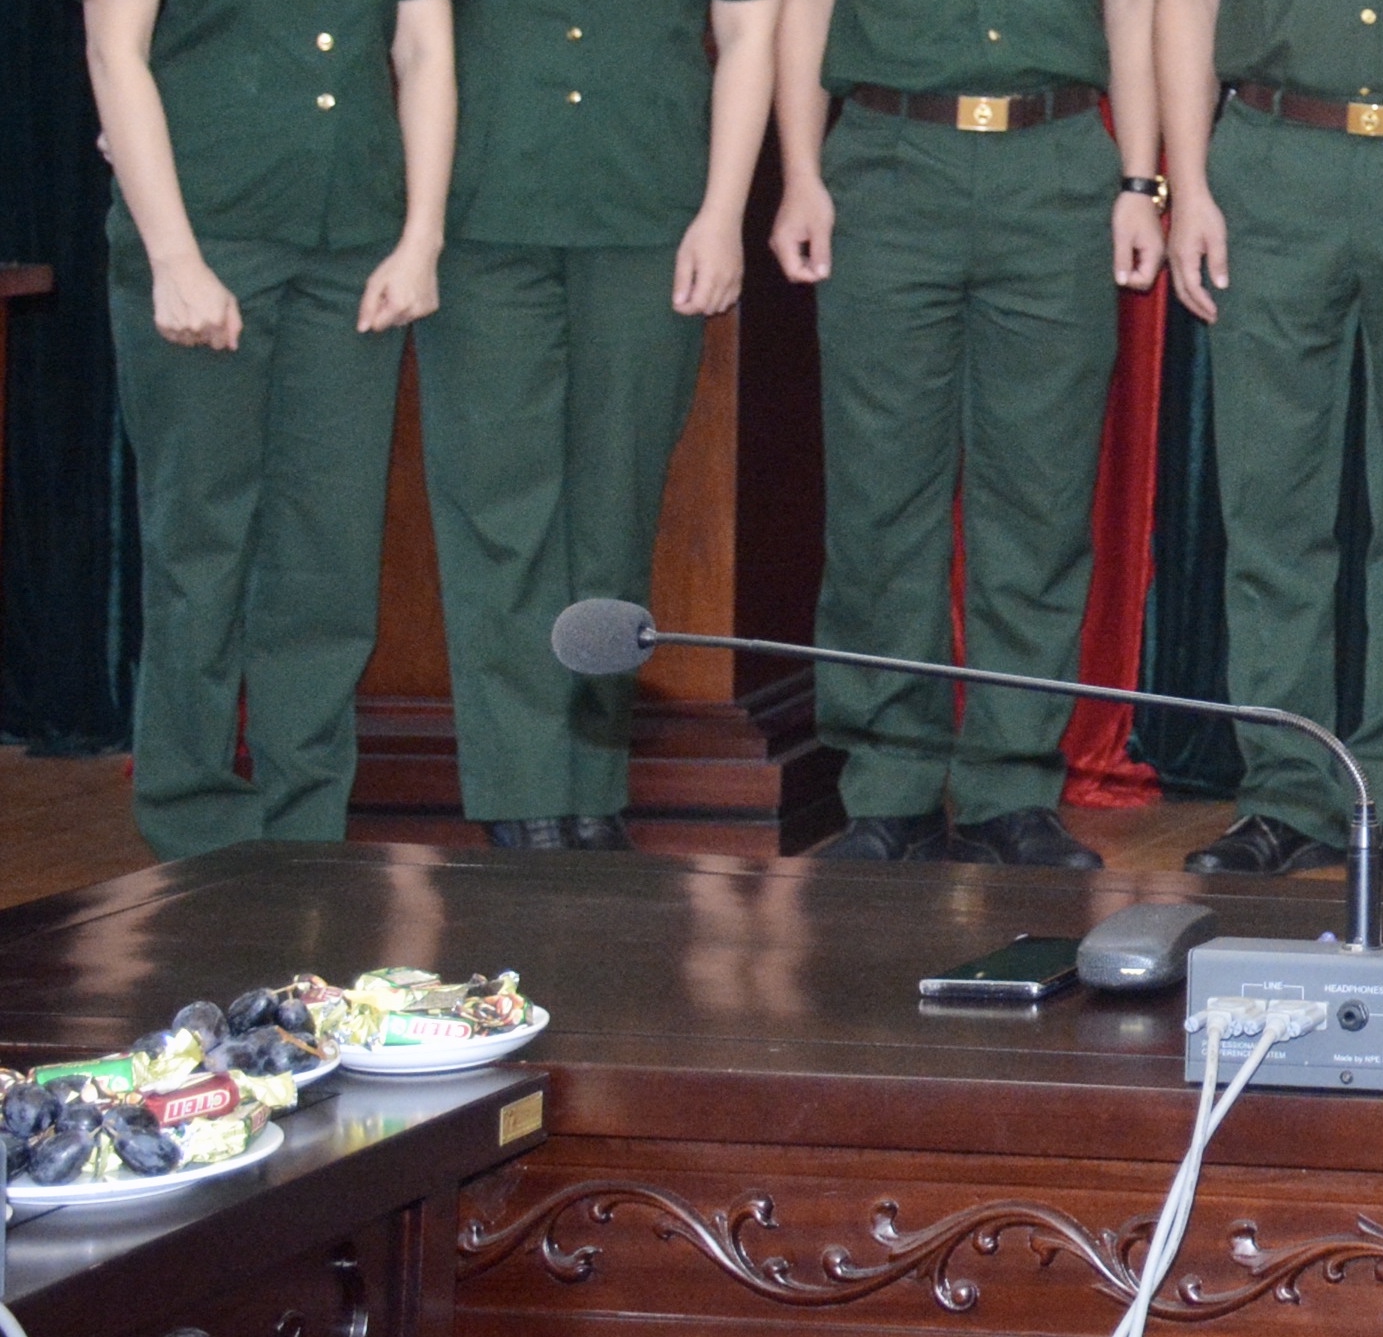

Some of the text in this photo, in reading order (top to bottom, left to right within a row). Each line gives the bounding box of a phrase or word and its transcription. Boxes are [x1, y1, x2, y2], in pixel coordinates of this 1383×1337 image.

[1263, 980, 1284, 991] LINE
[1333, 1053, 1353, 1062] Made
[1354, 1055, 1363, 1064] by
[1364, 1055, 1380, 1063] NPE
